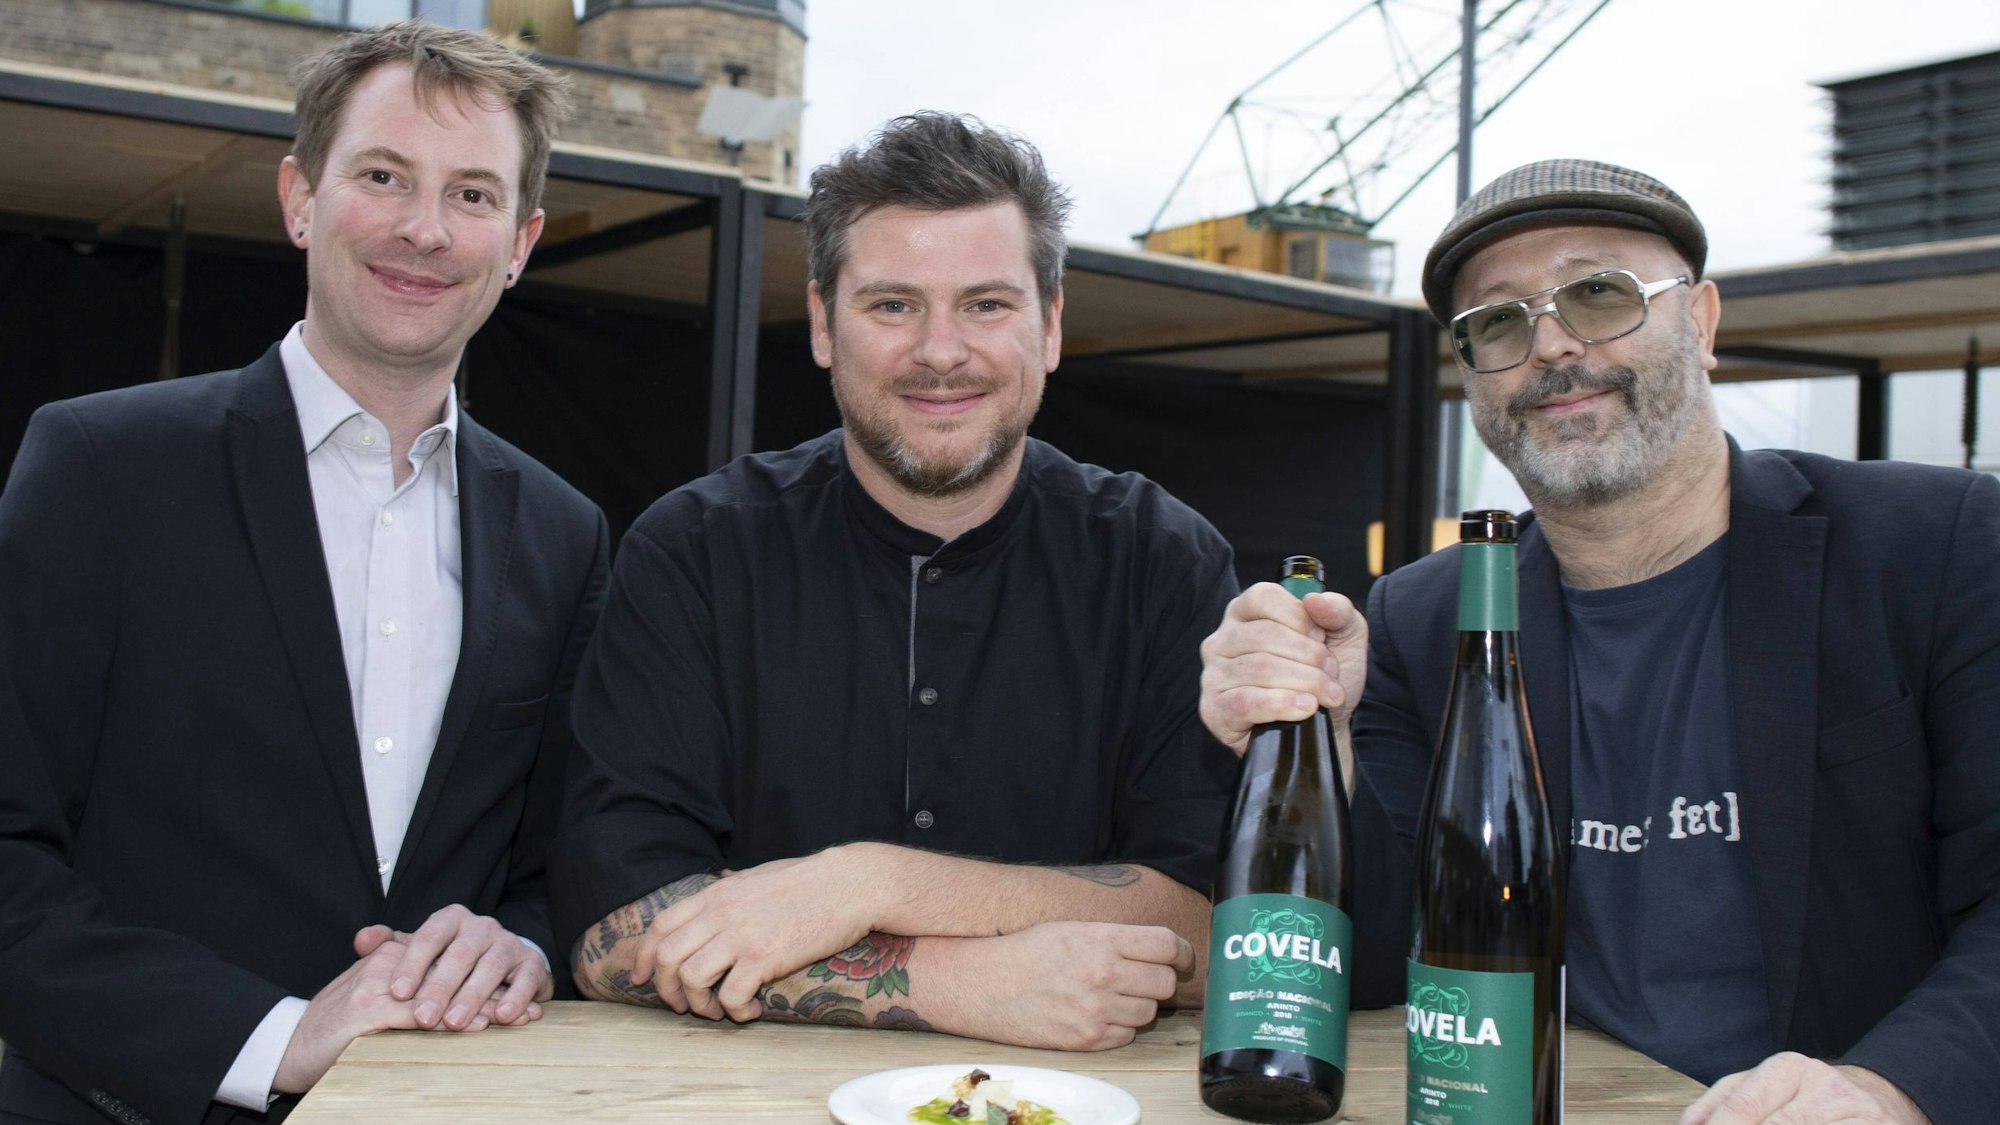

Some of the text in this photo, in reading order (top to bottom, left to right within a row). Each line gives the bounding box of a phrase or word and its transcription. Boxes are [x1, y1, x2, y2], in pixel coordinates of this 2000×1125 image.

[1223, 931, 1343, 975] COVELA
[1229, 989, 1333, 1012] EDIÇÃO NACIONAL
[1267, 1002, 1300, 1012] ARINTO
[1302, 1017, 1322, 1025] WHITE
[1406, 1003, 1501, 1046] OVELA
[1426, 1076, 1489, 1094] NACIONAL
[1420, 1087, 1447, 1099] ARINTO
[1449, 1103, 1472, 1111] WHITE
